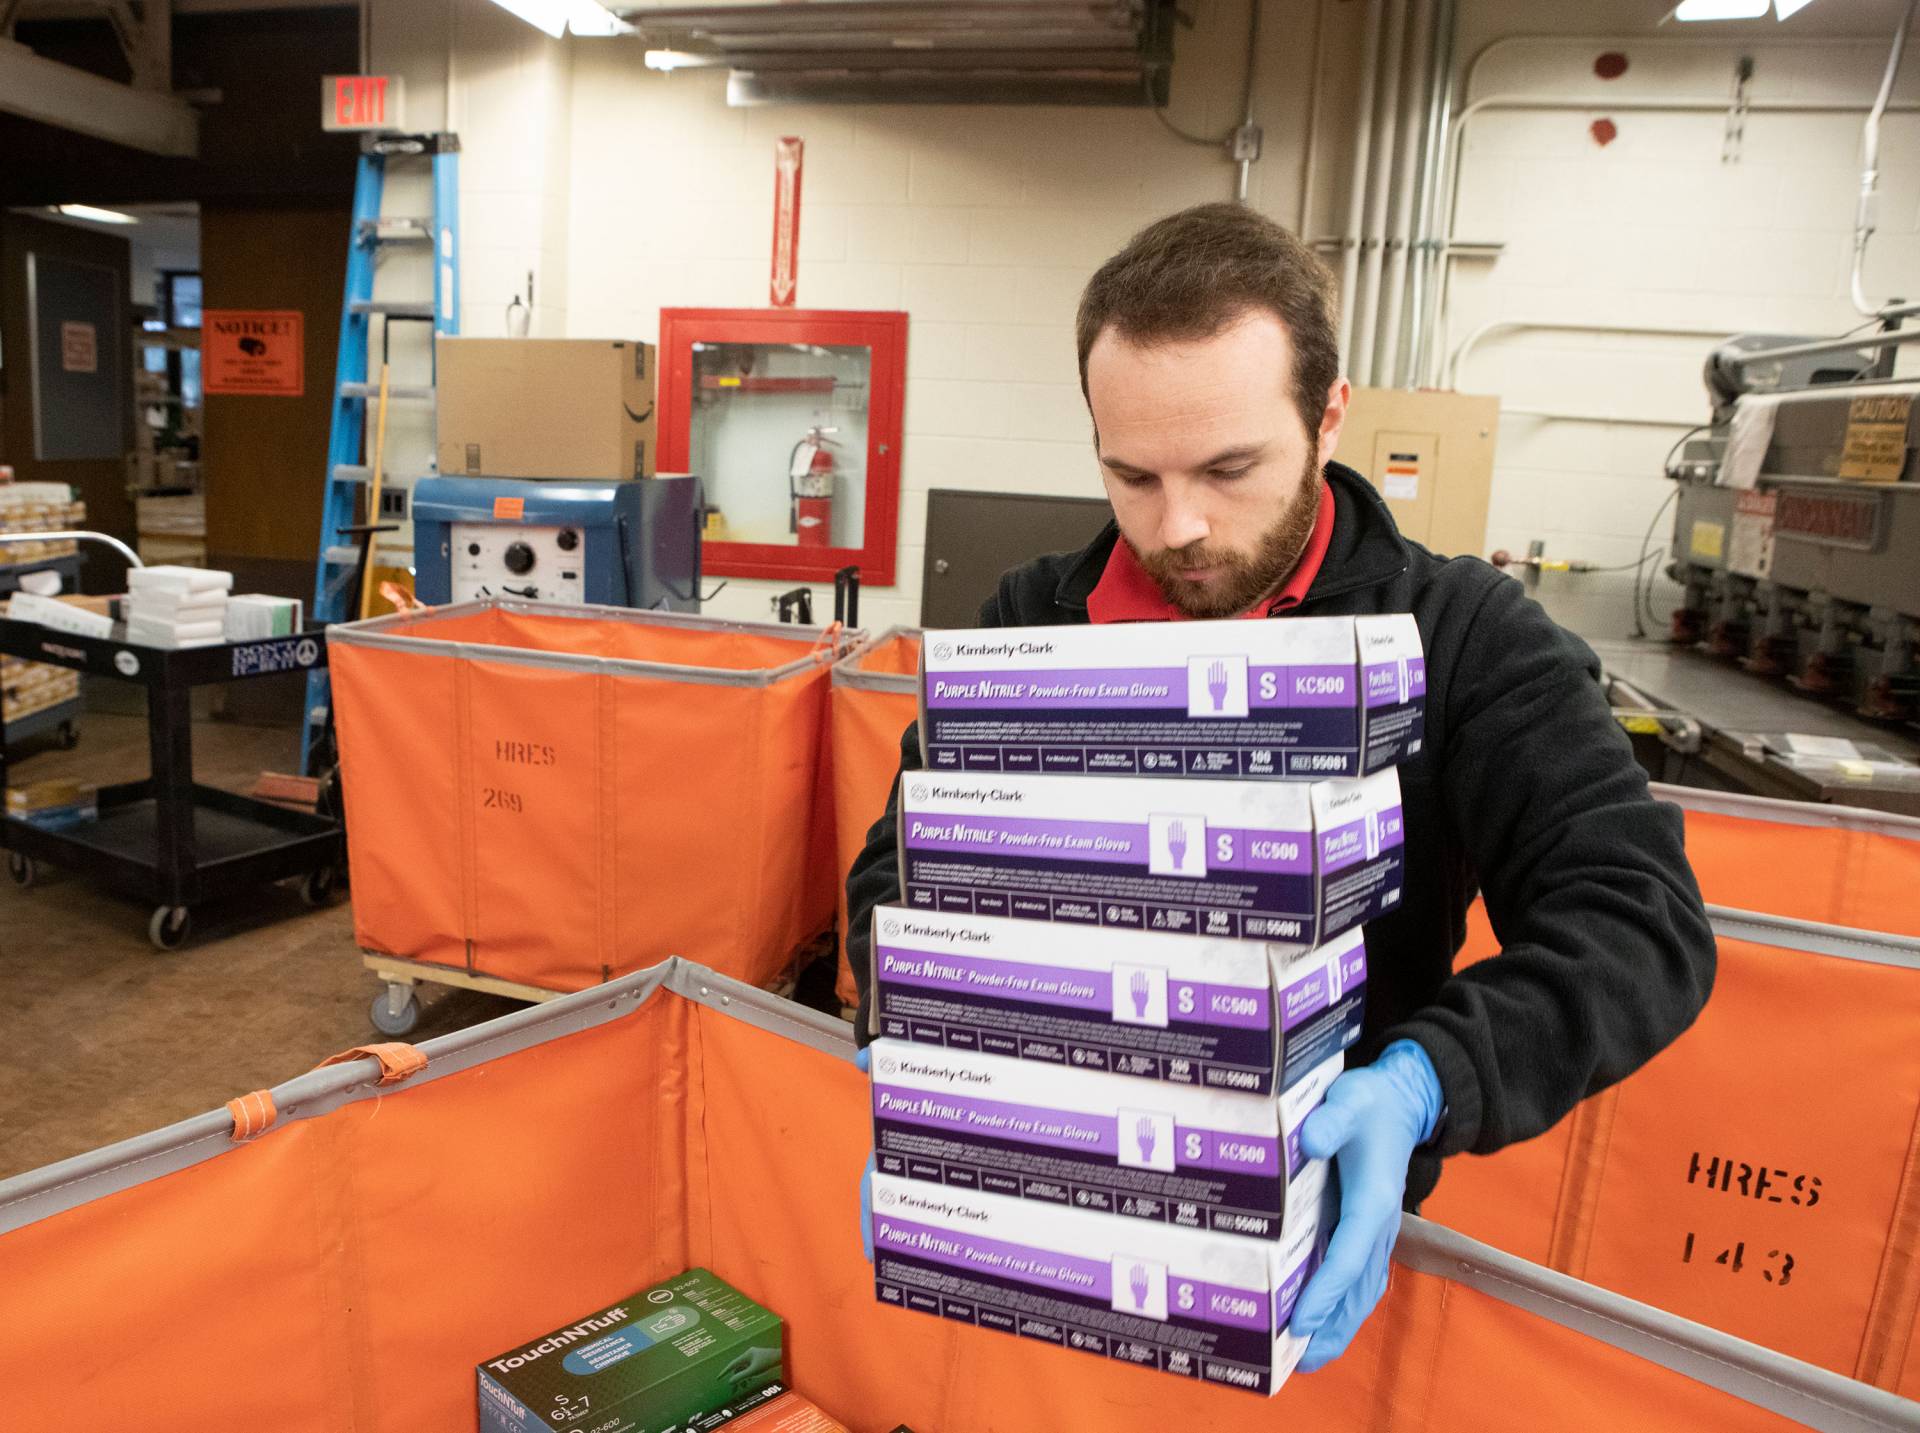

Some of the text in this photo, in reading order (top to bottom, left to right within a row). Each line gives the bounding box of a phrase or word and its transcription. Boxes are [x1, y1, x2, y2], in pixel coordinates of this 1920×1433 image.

[335, 76, 389, 125] EXIT
[956, 643, 1054, 657] Kimberly-Clark
[934, 681, 977, 698] PURPLE
[1029, 684, 1096, 698] Powder-Free
[1098, 684, 1128, 697] Exam
[1130, 683, 1168, 697] Gloves
[1259, 672, 1278, 700] S
[1296, 676, 1345, 695] KC500
[496, 740, 555, 765] HRES
[483, 788, 522, 813] 269
[932, 787, 1024, 803] Kimberly-Clark
[911, 821, 951, 840] PURPLE
[1000, 831, 1063, 849] Powder-Free
[1064, 834, 1094, 850] Exam
[1094, 836, 1131, 853] Gloves
[1216, 833, 1234, 862] S
[1251, 841, 1298, 860] KC500
[903, 923, 991, 943] Kimberly-Clark
[884, 955, 922, 976] PURPLE
[968, 971, 1029, 991] Powder-Free
[1030, 978, 1058, 995] Exam
[1059, 982, 1095, 999] Gloves
[1178, 986, 1195, 1014] S
[1211, 994, 1258, 1017] KC500
[900, 1062, 992, 1085] Kimberly-Clark
[880, 1092, 919, 1114] PURPLE
[968, 1110, 1032, 1132] Powder-Free
[1033, 1119, 1062, 1137] Exam
[1063, 1124, 1100, 1142] Gloves
[1185, 1133, 1202, 1160] S
[1219, 1142, 1266, 1164] KC500
[1687, 1152, 1823, 1207] HRES
[899, 1194, 991, 1223] Kimberly-Clark
[879, 1222, 918, 1247] PURPLE
[964, 1247, 1028, 1272] Powder-Free
[1028, 1260, 1057, 1280] Exam
[1058, 1266, 1095, 1287] Gloves
[1177, 1283, 1195, 1310] S
[1210, 1293, 1258, 1318] KC500
[1683, 1232, 1795, 1286] 143
[488, 1308, 628, 1374] TouchNTuff
[576, 1337, 614, 1355] CHEMICAL
[581, 1336, 626, 1360] RESISTANCE
[479, 1372, 526, 1420] TouchNTuff
[554, 1394, 569, 1405] S
